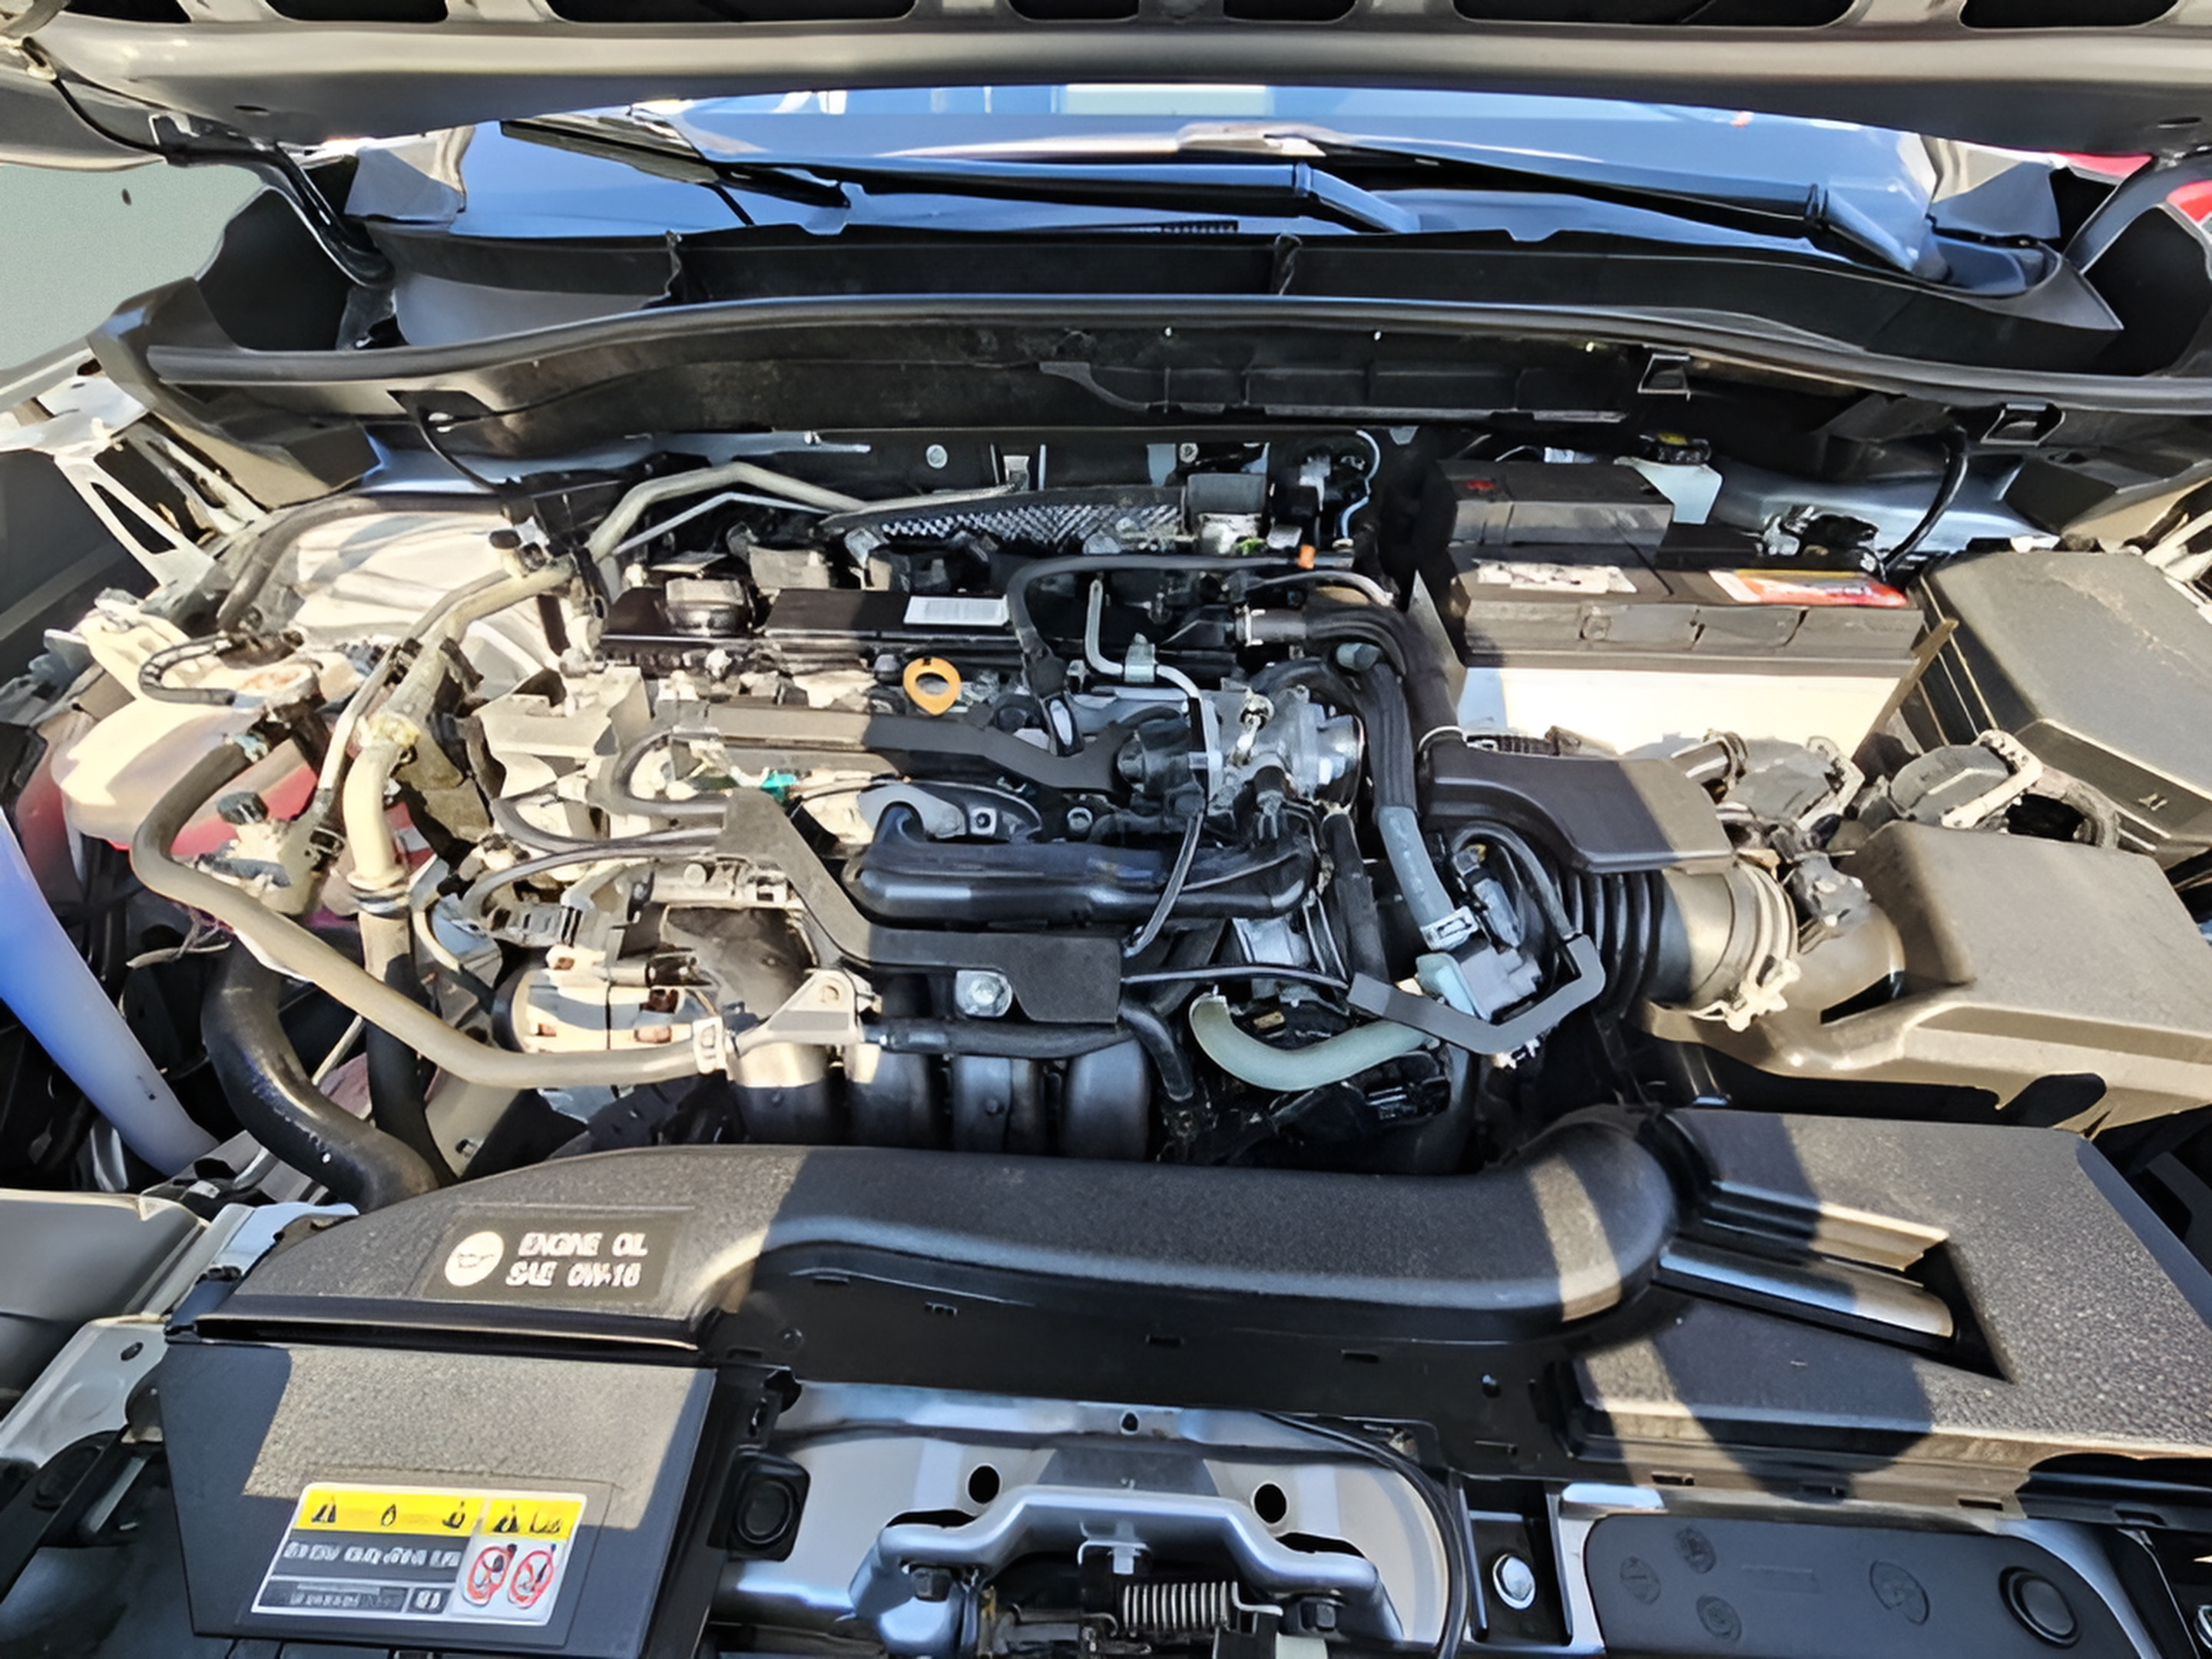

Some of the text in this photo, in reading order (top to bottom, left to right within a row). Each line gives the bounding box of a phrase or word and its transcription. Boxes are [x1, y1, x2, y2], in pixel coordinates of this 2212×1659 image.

[518, 1232, 649, 1257] ENGINE OIL
[505, 1260, 558, 1286] SAE
